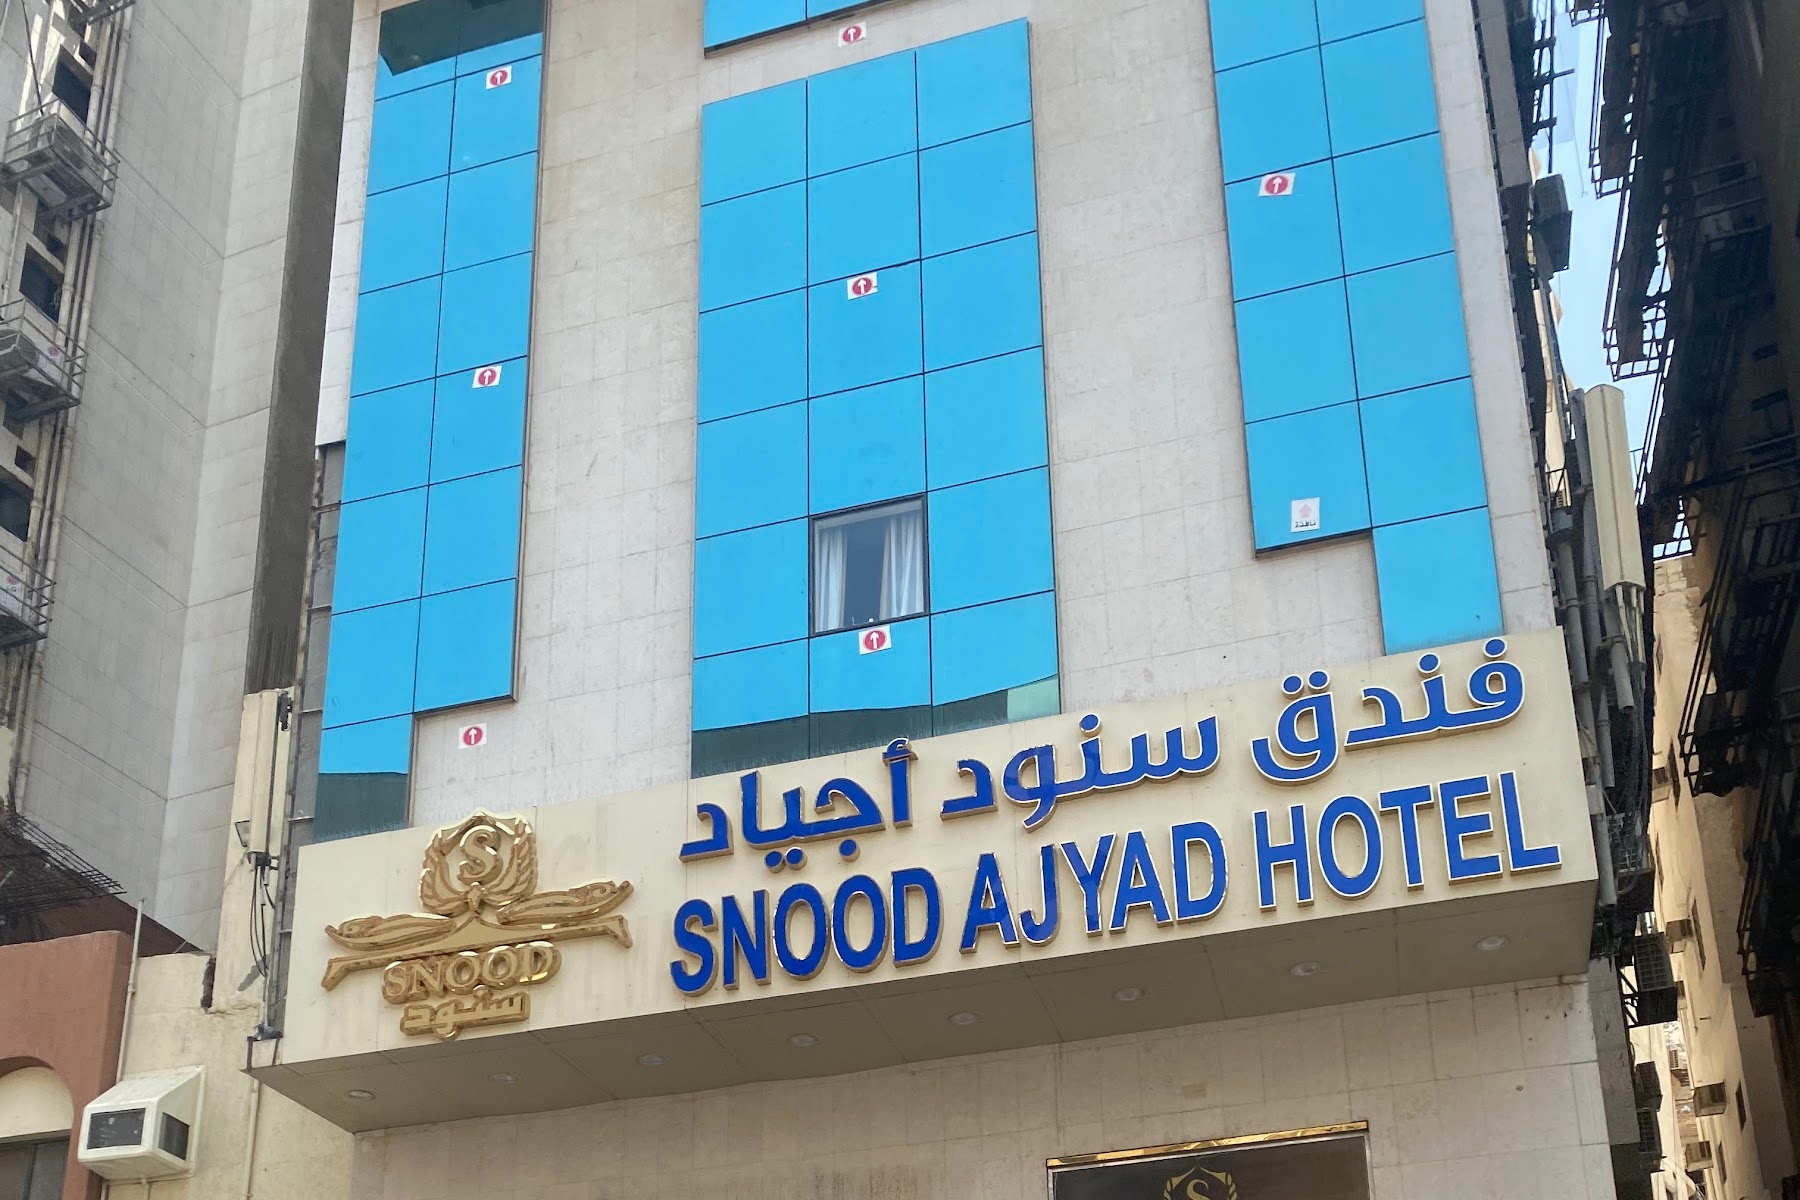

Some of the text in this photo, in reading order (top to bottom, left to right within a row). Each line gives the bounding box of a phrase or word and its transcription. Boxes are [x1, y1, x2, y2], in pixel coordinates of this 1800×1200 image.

[679, 638, 1526, 872] فندق سنود أجياد
[670, 771, 1562, 997] SNOOD AJYAD HOTEL
[382, 940, 561, 1004] SNOOD
[400, 984, 530, 1040] سنود
